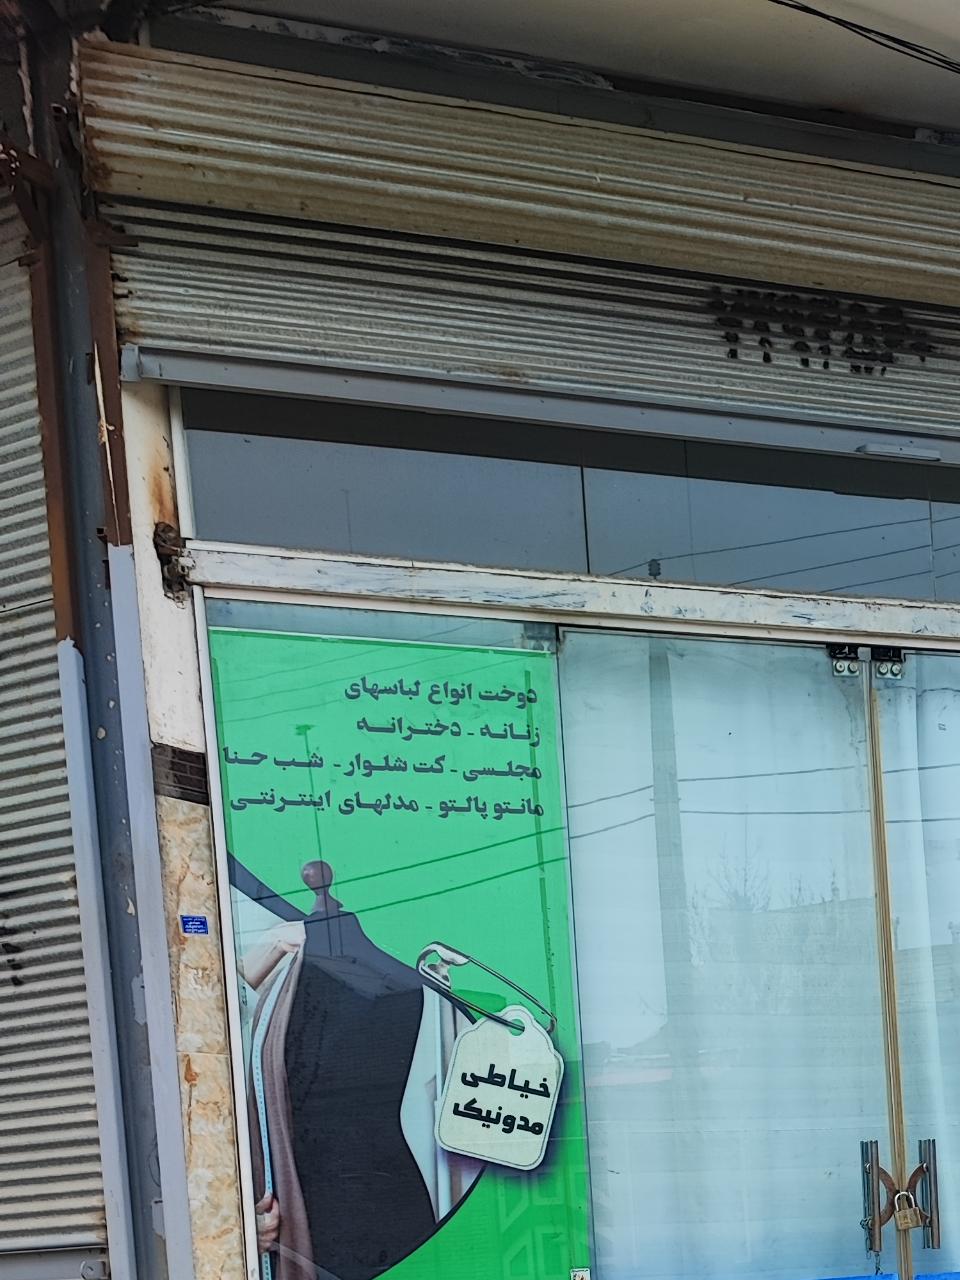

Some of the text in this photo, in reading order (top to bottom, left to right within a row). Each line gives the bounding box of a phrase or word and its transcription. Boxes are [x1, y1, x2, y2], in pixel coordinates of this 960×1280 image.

[344, 676, 538, 710] دوخت انواع لباسهای
[356, 716, 462, 741] دخترانه
[479, 722, 541, 747] زنانه
[222, 746, 268, 766] حنا
[273, 752, 324, 771] شب
[343, 753, 408, 777] شلوار
[412, 755, 446, 774] کت
[462, 760, 542, 782] مجلسی
[230, 788, 331, 813] اینترنتی
[338, 790, 419, 816] مدلهای
[438, 796, 488, 820] پالتو
[492, 798, 544, 820] مانتو
[460, 1063, 551, 1099] خیاطی
[452, 1097, 544, 1136] مدونیک
